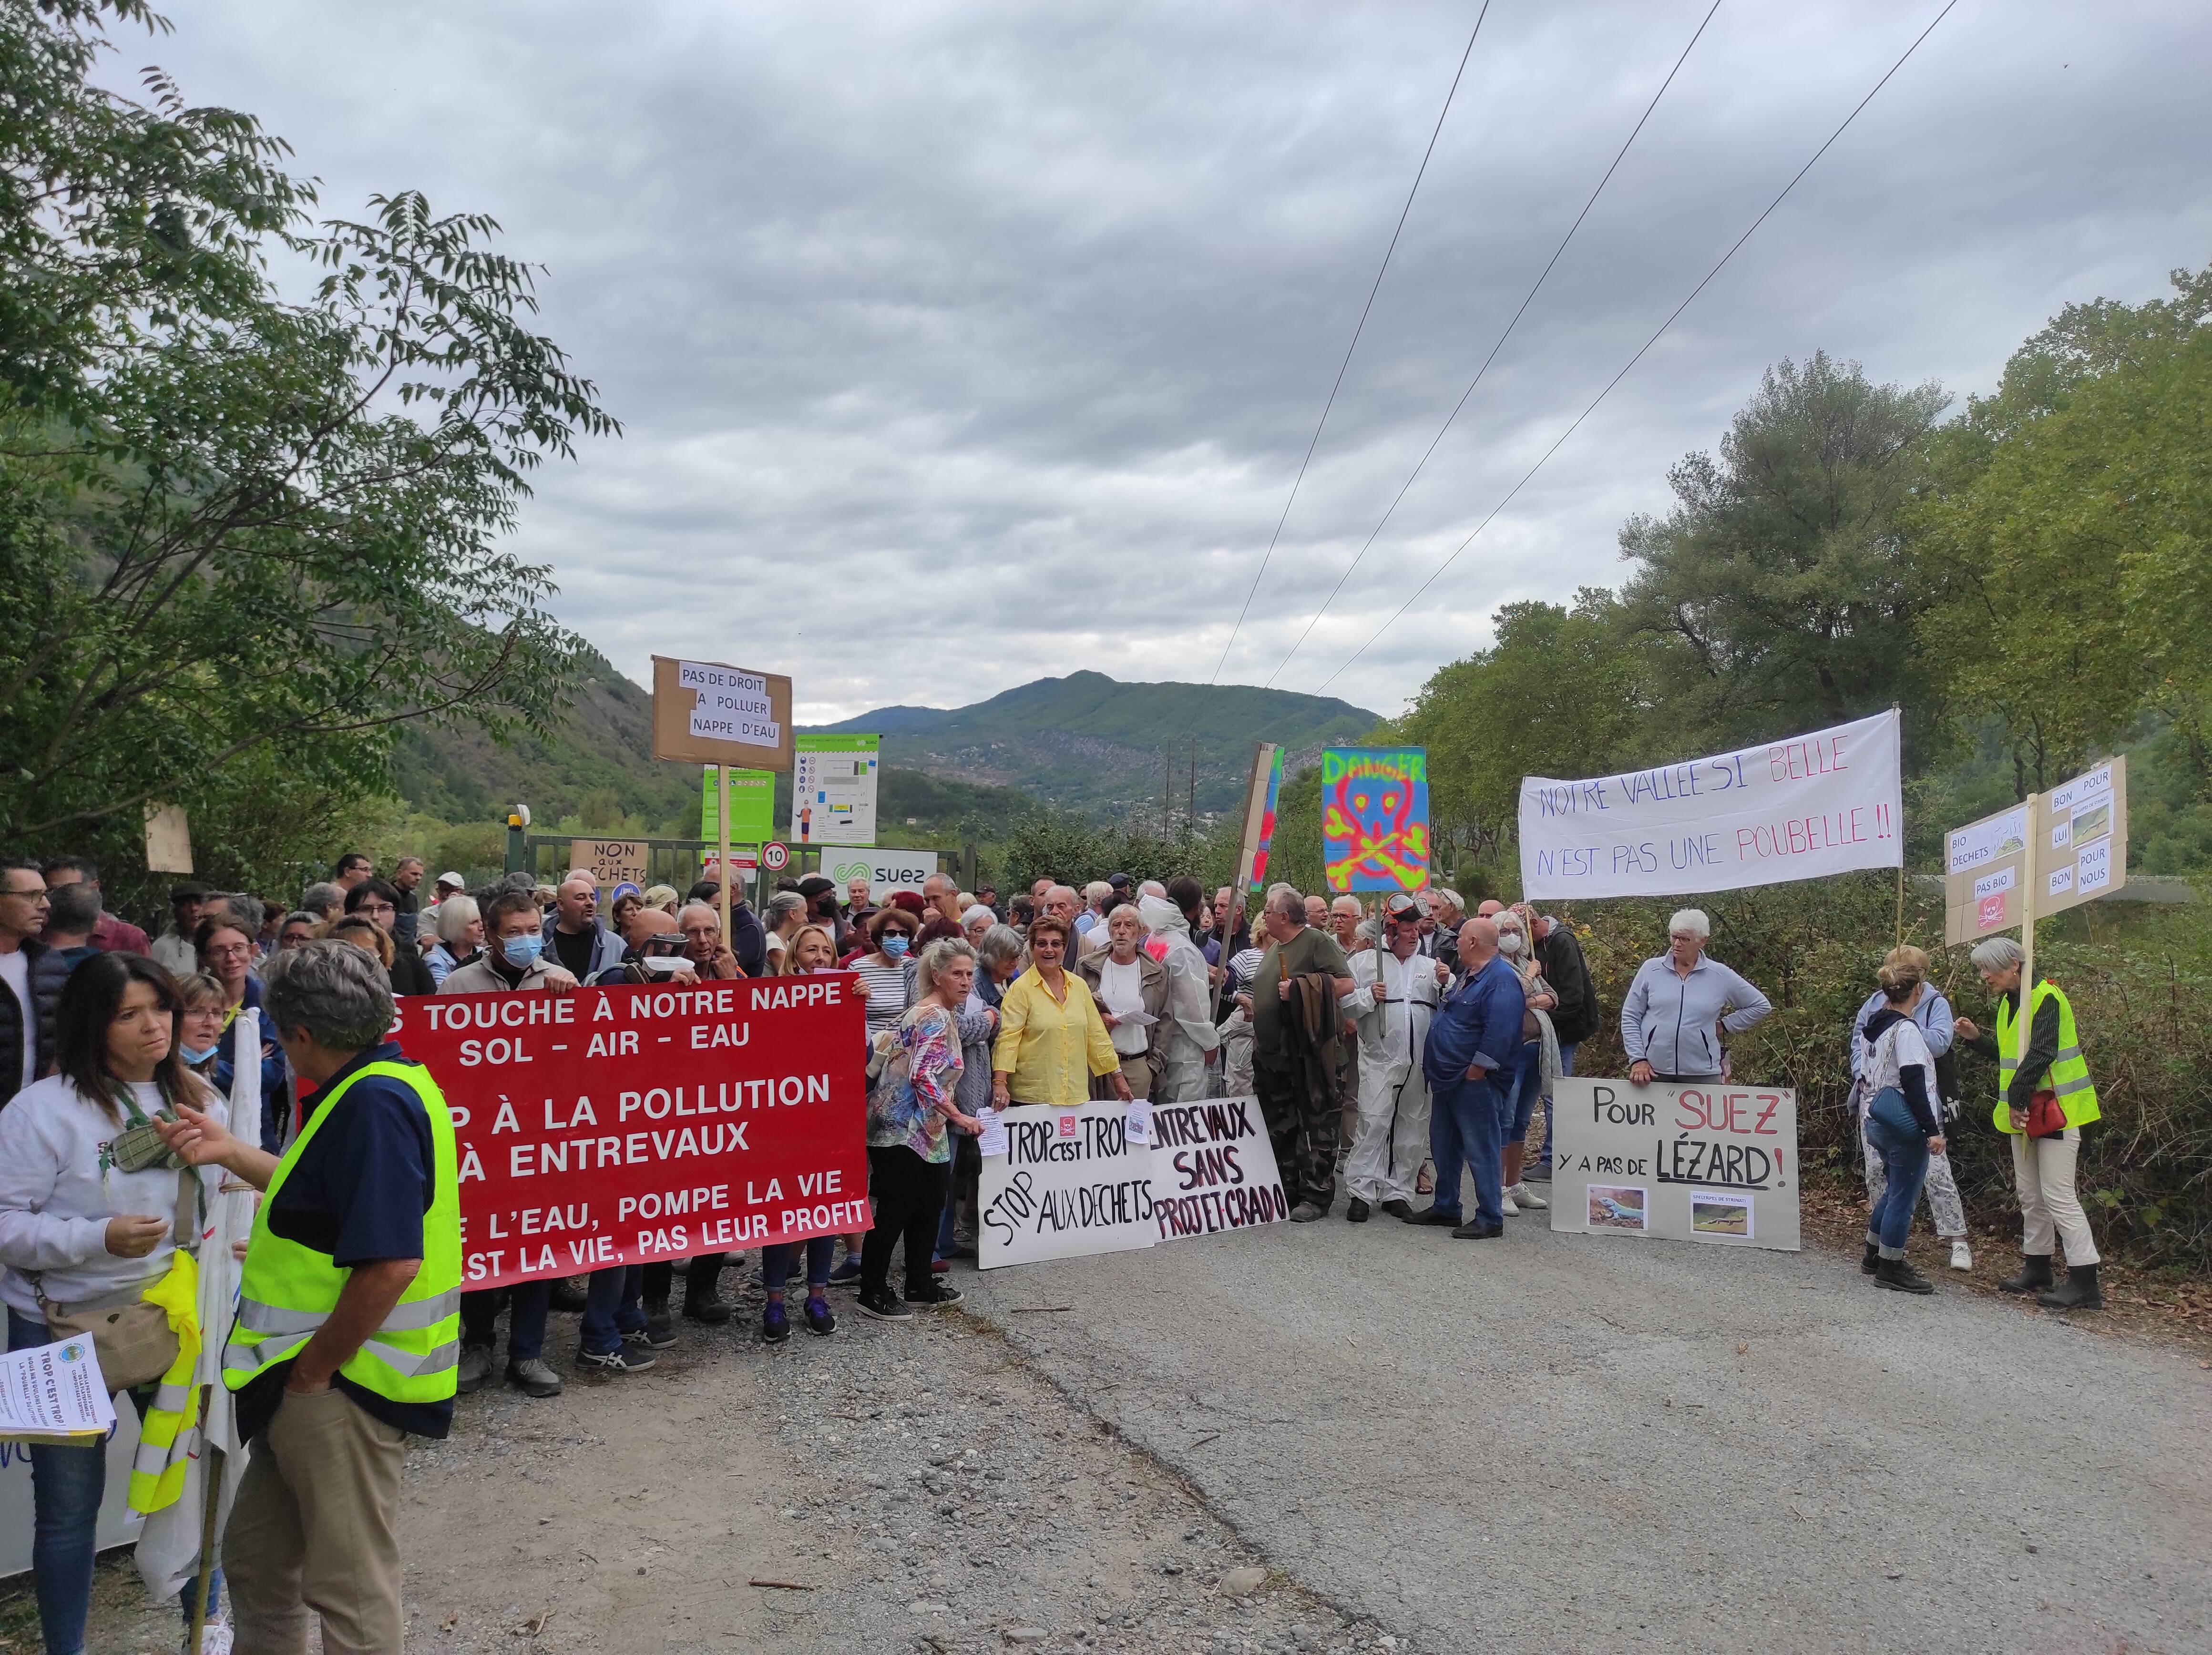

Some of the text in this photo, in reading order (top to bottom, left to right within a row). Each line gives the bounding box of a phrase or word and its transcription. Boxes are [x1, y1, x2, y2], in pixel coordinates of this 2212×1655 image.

[683, 669, 763, 691] PAS DE DROIT
[698, 693, 767, 715] A POLLUER
[694, 718, 775, 738] NAPPE D'EAU
[1321, 751, 1427, 784] DANGER
[1540, 779, 1612, 818] NOTRE
[1709, 754, 1749, 791] SI
[1769, 735, 1849, 782] BELLE
[2055, 772, 2108, 807] BON POUR
[1537, 848, 1600, 876] N'EST
[1613, 843, 1658, 874] PAS
[1670, 833, 1724, 869] UNE
[1737, 807, 1868, 861] POUBELLE
[1953, 837, 1966, 848] BIO
[2055, 830, 2067, 843] LUI
[594, 844, 635, 857] NON
[768, 851, 782, 862] 10
[1953, 847, 1988, 867] DECHETS
[2081, 848, 2105, 867] POUR
[875, 868, 925, 882] suez
[1977, 876, 2007, 894] PAS BIO
[2052, 871, 2070, 887] BON
[2080, 868, 2105, 886] NOUS
[424, 999, 574, 1030] TOUCHE
[593, 991, 614, 1021] À
[631, 990, 733, 1018] NOTRE
[752, 982, 840, 1010] NAPPE
[460, 1038, 533, 1066] SOL
[586, 1031, 638, 1057] AIR
[692, 1022, 748, 1049] EAU
[492, 1095, 520, 1134] À
[545, 1096, 597, 1129] LA
[620, 1074, 829, 1122] POLLUTION
[1594, 1087, 1655, 1125] POUR
[458, 1120, 749, 1183] À ENTREVAUX
[1004, 1121, 1053, 1165] TROP
[1173, 1145, 1243, 1190] SANS
[1558, 1154, 1572, 1171] Y
[1578, 1155, 1590, 1172] A
[1597, 1157, 1622, 1175] PAS
[1628, 1159, 1647, 1175] DE
[490, 1203, 598, 1238] L'EAU,
[619, 1185, 730, 1225] POMPE
[748, 1178, 784, 1204] LA
[798, 1170, 841, 1196] VIE
[983, 1171, 1152, 1246] STOP AUX DECHETS
[1153, 1183, 1286, 1239] PROJET CRADO
[521, 1245, 557, 1272] LA
[569, 1236, 623, 1265] VIE,
[638, 1226, 687, 1255] PAS
[703, 1215, 768, 1245] LEUR
[782, 1200, 864, 1234] PROFIT
[27, 1356, 35, 1372] NOUS
[30, 1372, 36, 1380] NE
[41, 1351, 53, 1377] TROP
[31, 1380, 41, 1405] VOULONS
[45, 1379, 59, 1403] C'EST
[50, 1404, 64, 1423] TROP
